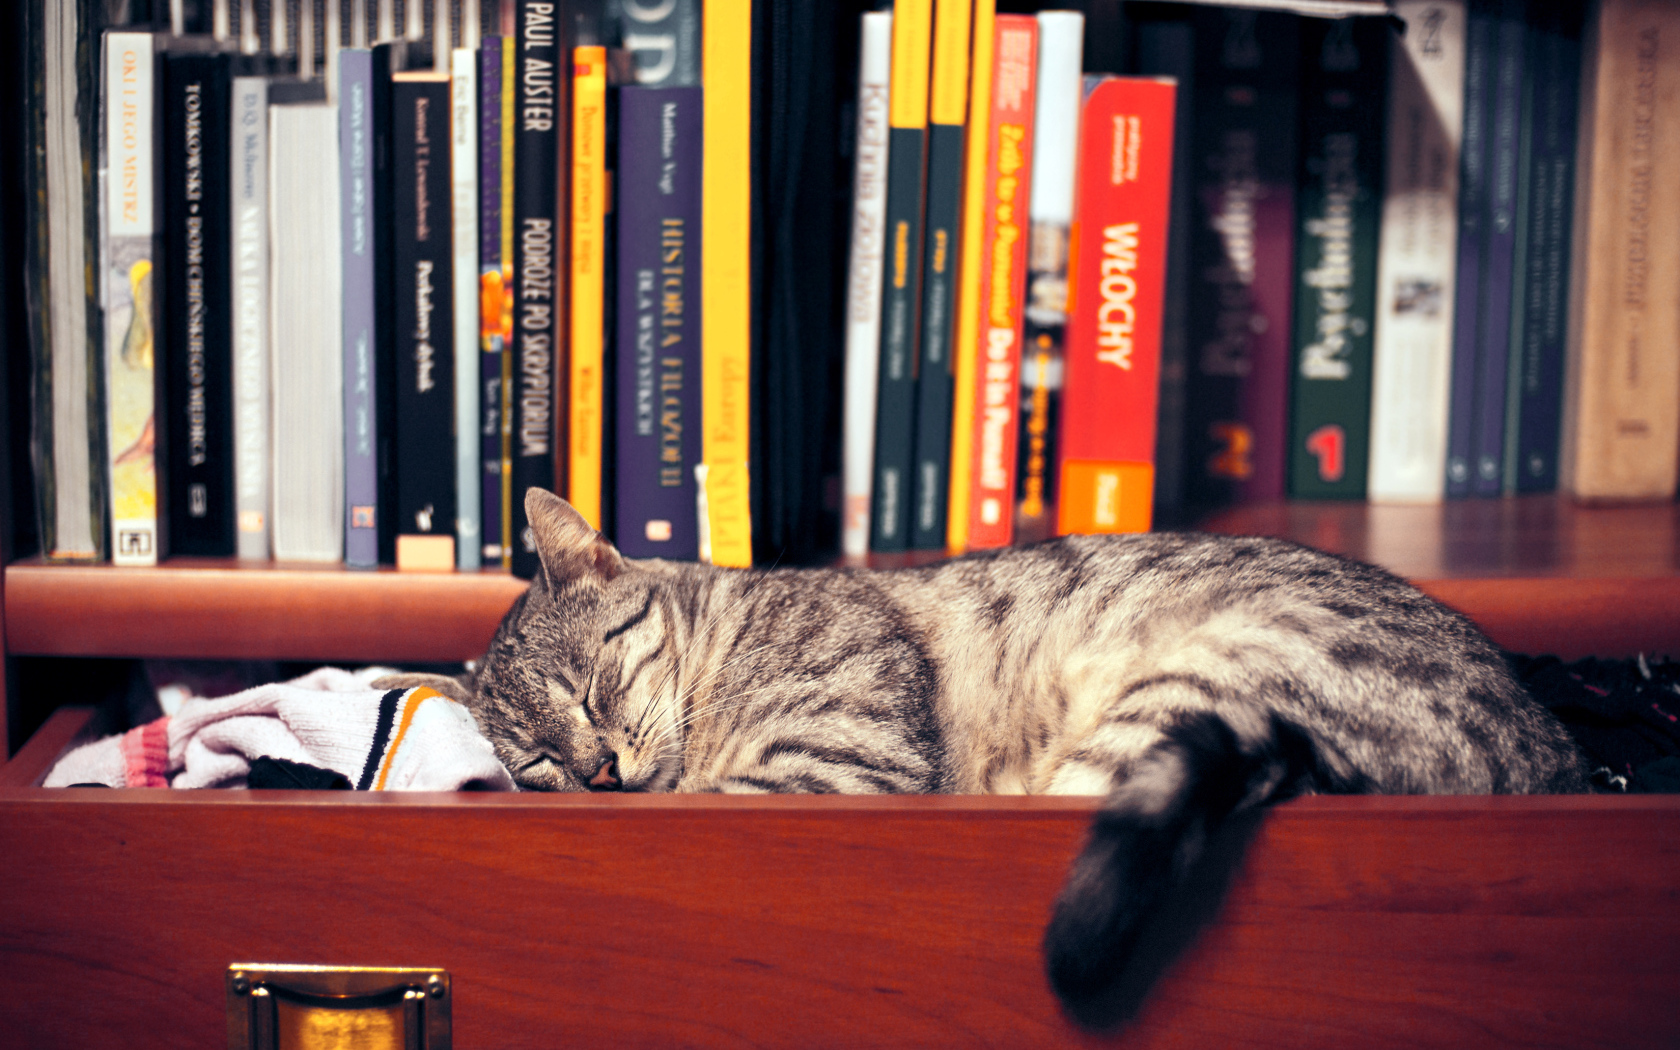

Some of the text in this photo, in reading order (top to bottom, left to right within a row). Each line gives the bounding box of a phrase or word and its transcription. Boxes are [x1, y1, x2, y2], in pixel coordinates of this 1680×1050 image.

[122, 50, 137, 82] OKI
[456, 75, 470, 101] Eric
[523, 2, 554, 132] PAUL AUSTER
[122, 100, 137, 149] JEGO
[185, 81, 203, 201] TOMKOWSKI
[416, 97, 431, 144] Konrad
[859, 82, 889, 200] Kuchnia
[122, 155, 138, 224] MISTRZ
[521, 304, 551, 330] PO
[1095, 221, 1140, 371] WŁOCHY
[637, 269, 654, 436] DLA WSZYSTKICH
[660, 218, 685, 487] HISTORIA FILOZOFII
[985, 361, 1014, 380] it
[988, 328, 1015, 360] Do
[521, 333, 551, 457] SKRYPTORIUM
[985, 382, 1013, 405] in
[711, 356, 744, 548] PTAKI Europy
[1304, 424, 1346, 482] 1
